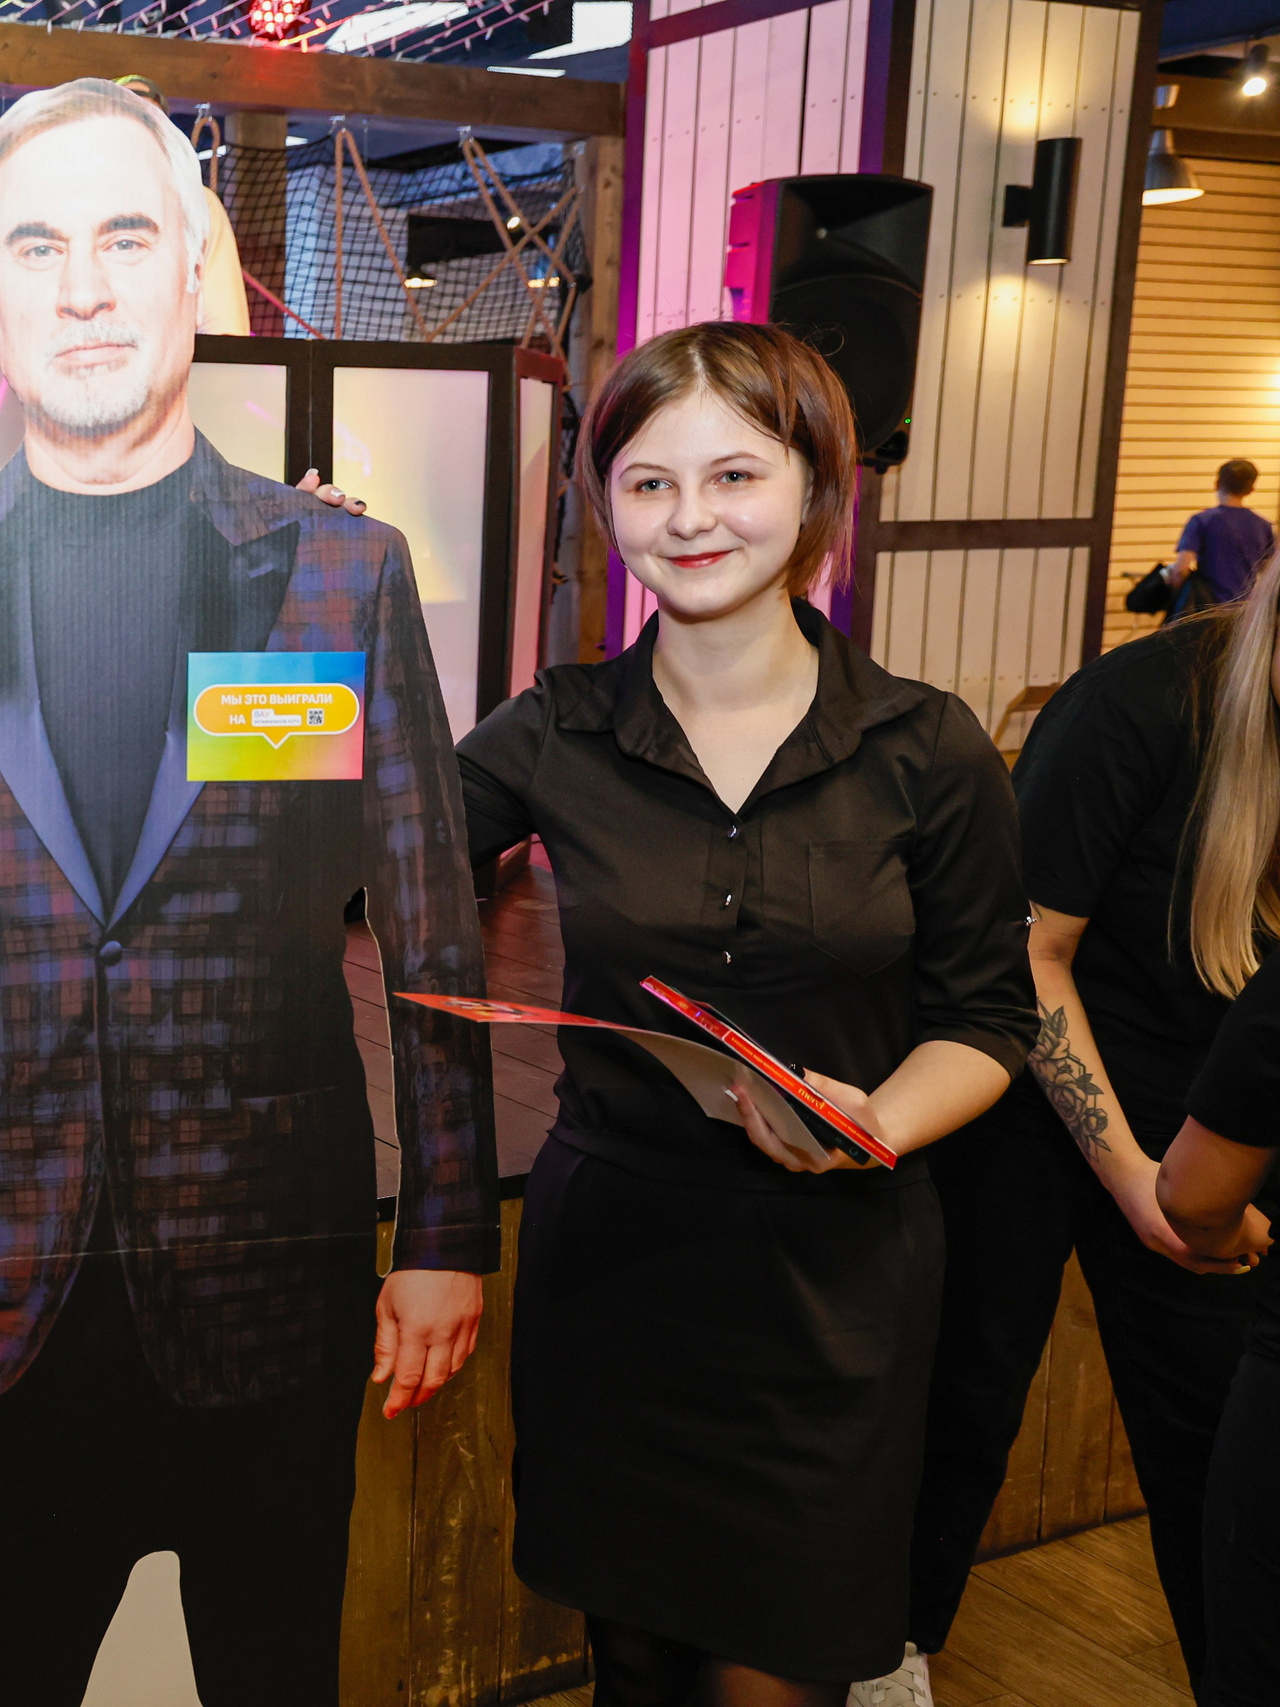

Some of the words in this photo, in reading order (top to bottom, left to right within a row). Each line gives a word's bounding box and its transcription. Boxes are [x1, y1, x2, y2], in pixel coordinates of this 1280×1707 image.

[220, 694, 242, 705] МЫ
[244, 693, 267, 705] ЭТО
[269, 693, 333, 705] ВЫИГРАЛИ
[229, 714, 246, 725] НА
